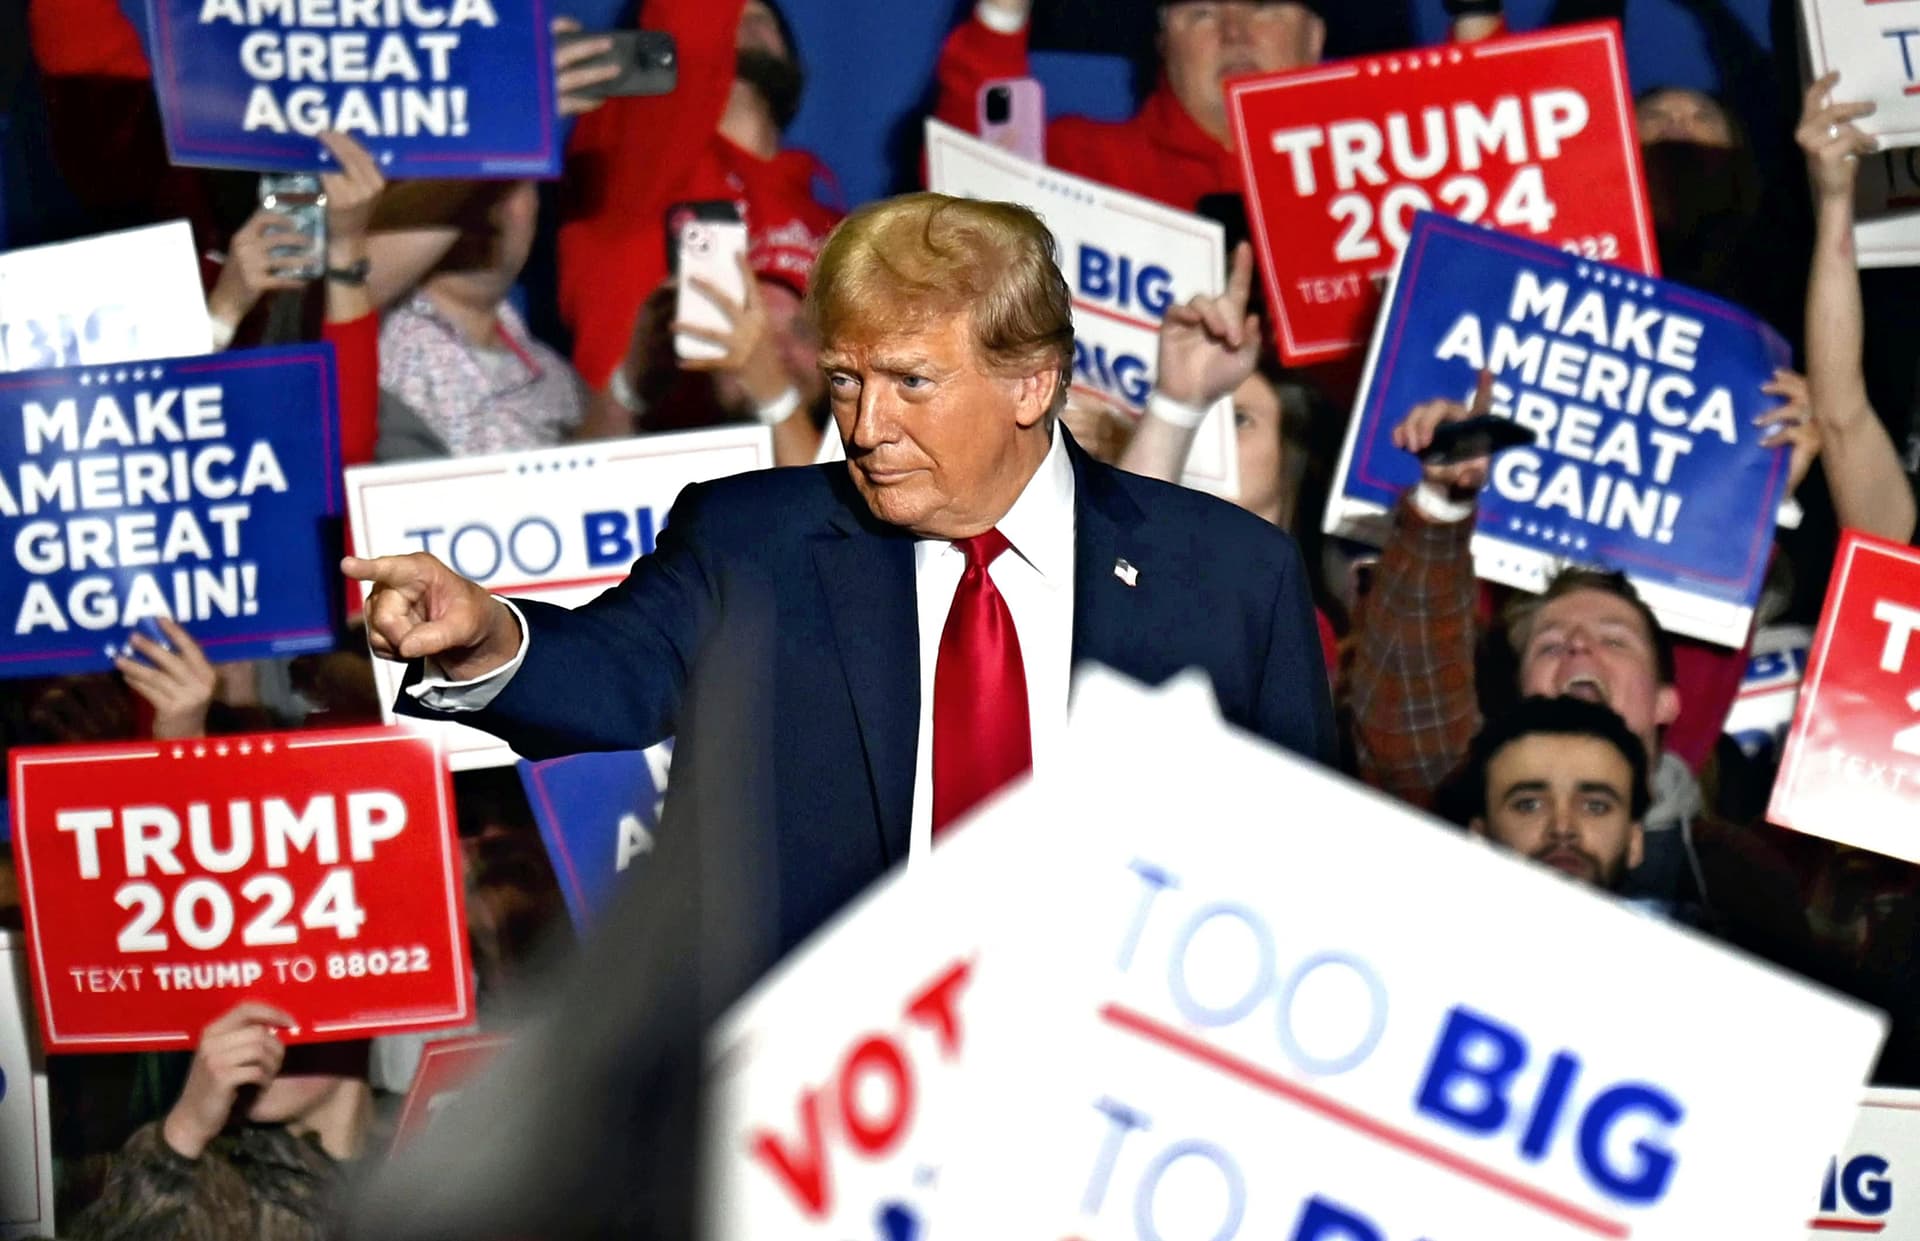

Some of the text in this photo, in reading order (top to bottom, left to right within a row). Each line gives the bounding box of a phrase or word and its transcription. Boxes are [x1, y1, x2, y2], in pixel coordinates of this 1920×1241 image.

[240, 31, 460, 82] GREAT
[242, 85, 469, 137] AGAIN!
[1271, 87, 1590, 197] TRUMP
[1328, 164, 1557, 262] 2024
[1077, 240, 1176, 318] BIG
[1296, 271, 1361, 305] TEXT
[1507, 270, 1704, 372] MAKE
[1434, 313, 1739, 445] AMERICA
[20, 385, 227, 456] MAKE
[1488, 448, 1683, 545] GAIN!
[13, 503, 251, 575] GREAT
[405, 505, 669, 582] TOO BI
[14, 563, 259, 635] AGAIN!
[55, 789, 409, 880] TRUMP
[112, 867, 367, 953] 2024
[69, 946, 431, 994] TEXT TRUMP TO 88022
[1115, 856, 1687, 1208] TOO BIG
[750, 956, 975, 1222] VOT
[1819, 1153, 1893, 1217] IG
